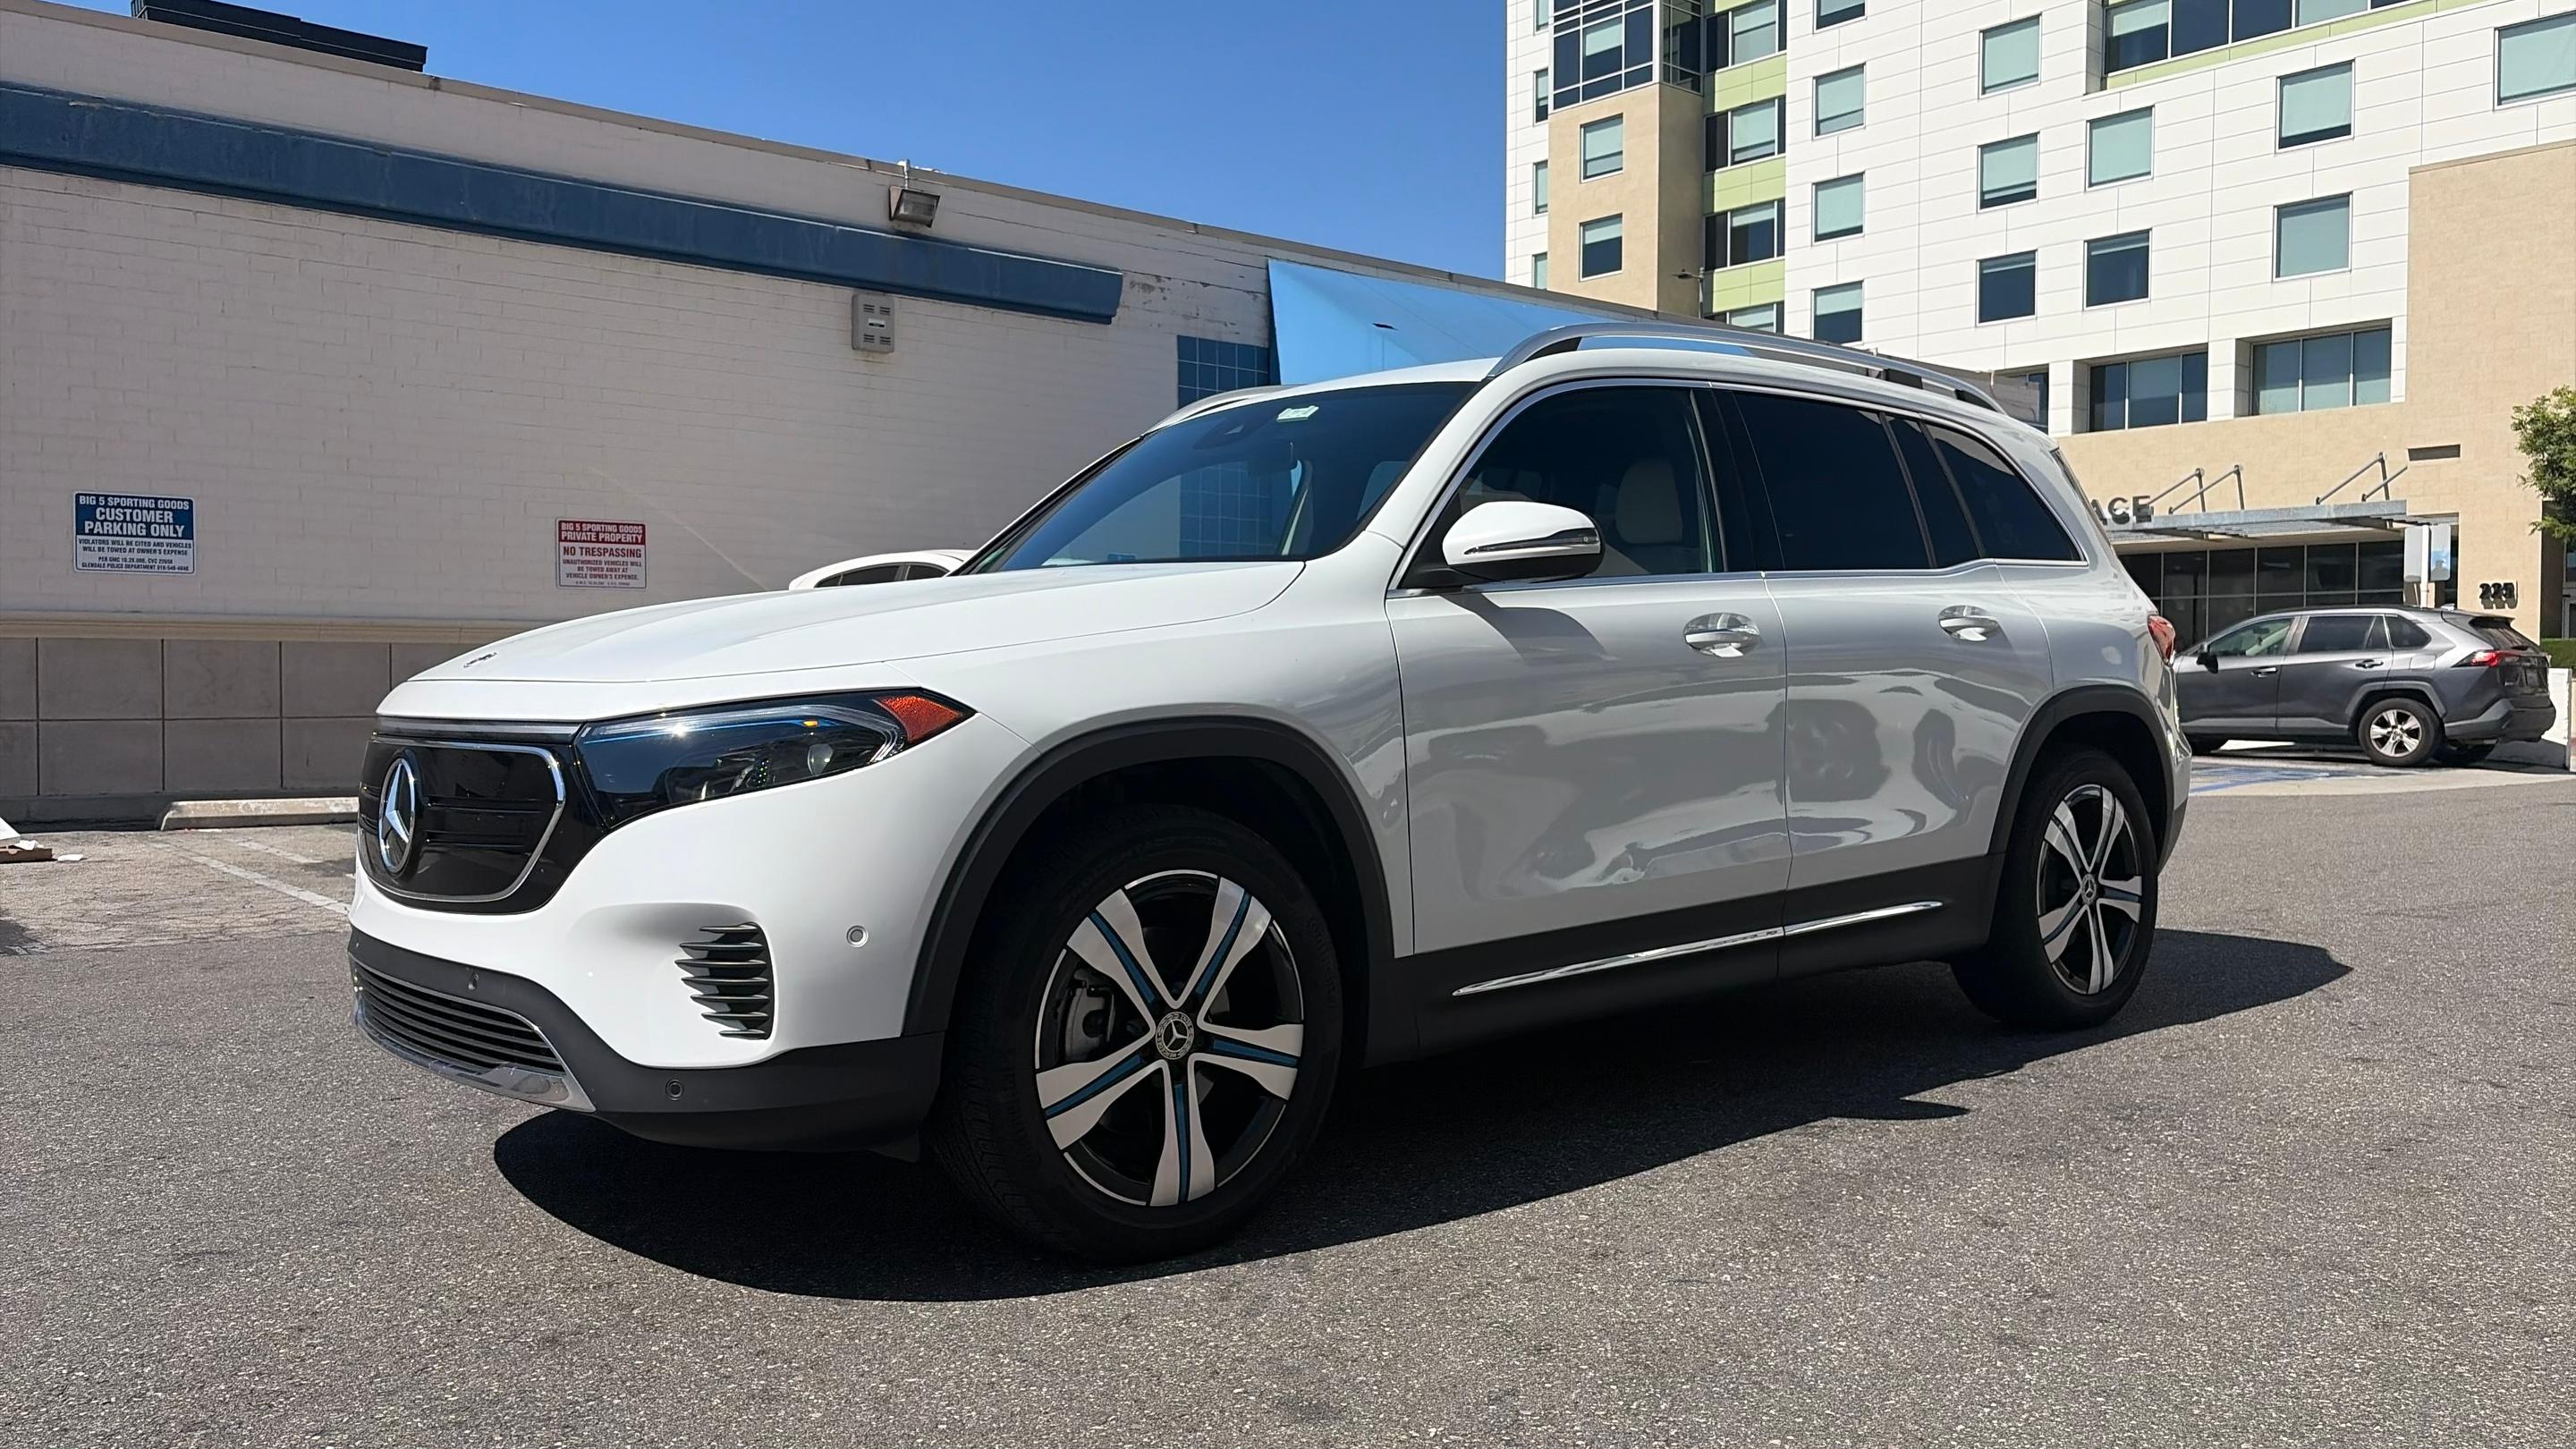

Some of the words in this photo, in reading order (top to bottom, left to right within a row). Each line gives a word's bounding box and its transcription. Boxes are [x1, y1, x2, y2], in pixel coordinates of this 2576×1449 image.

[80, 496, 96, 504] BIG
[98, 496, 105, 506] 5
[107, 497, 156, 508] SPORTING
[157, 500, 190, 510] GOODS
[96, 507, 174, 523] CUSTOMER
[85, 521, 147, 536] PARKING
[150, 523, 185, 538] ONLY
[561, 522, 573, 530] BIG
[575, 523, 581, 532] 5
[581, 523, 617, 532] SPORTING
[619, 525, 643, 534] GOODS
[562, 531, 597, 541] PRIVATE
[598, 533, 642, 543] PROPERTY
[564, 547, 576, 556] NO
[579, 547, 641, 558] TRESPASSING
